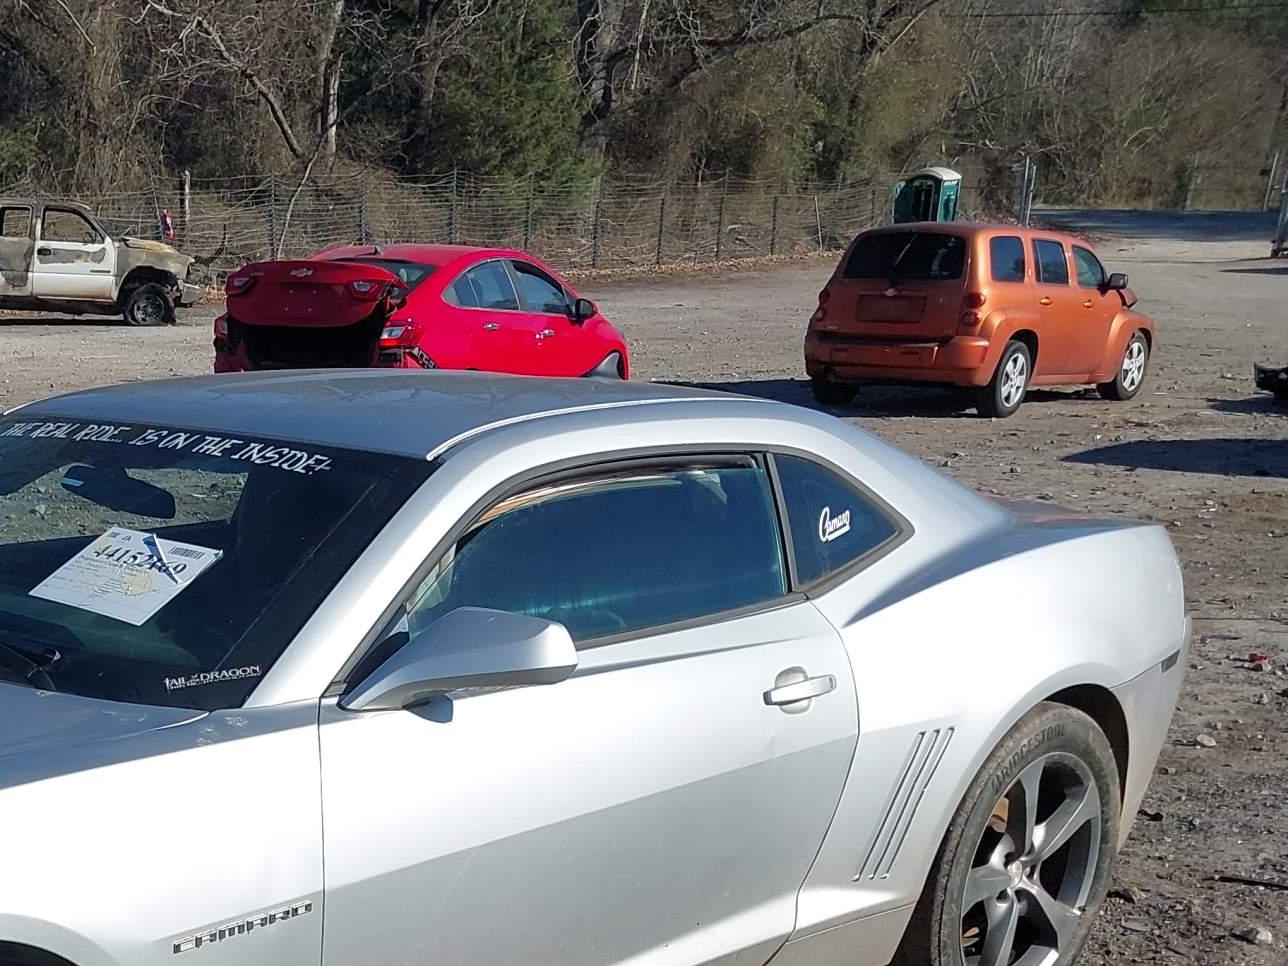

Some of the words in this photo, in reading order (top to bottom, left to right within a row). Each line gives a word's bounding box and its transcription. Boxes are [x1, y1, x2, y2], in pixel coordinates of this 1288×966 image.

[0, 422, 44, 436] THE
[29, 422, 81, 438] REAL
[128, 429, 168, 446] IS
[158, 432, 201, 450] ON
[191, 436, 244, 457] THE
[199, 665, 260, 682] DRAGON
[173, 900, 312, 954] CAMARO
